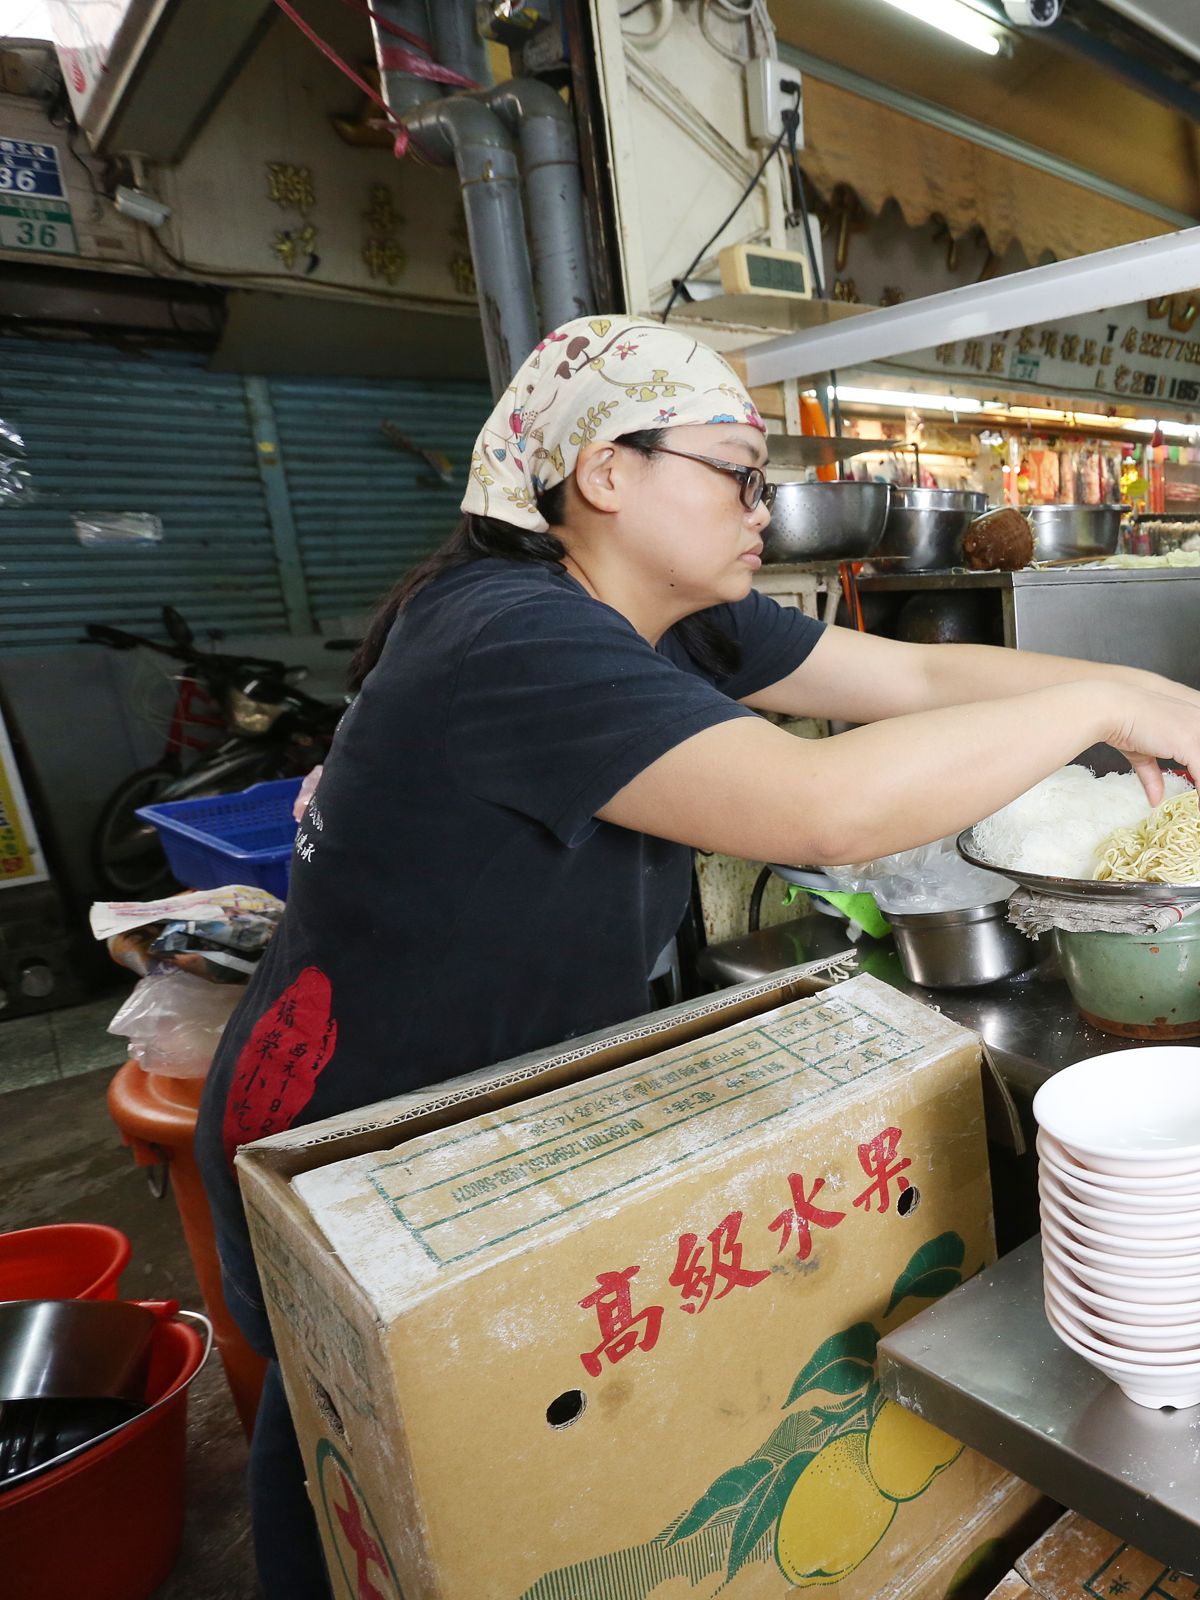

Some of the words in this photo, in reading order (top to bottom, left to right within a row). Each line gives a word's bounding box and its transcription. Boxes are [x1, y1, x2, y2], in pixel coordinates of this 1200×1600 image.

[0, 167, 36, 191] 36
[17, 221, 57, 248] 36
[579, 1126, 912, 1377] 高級水果
